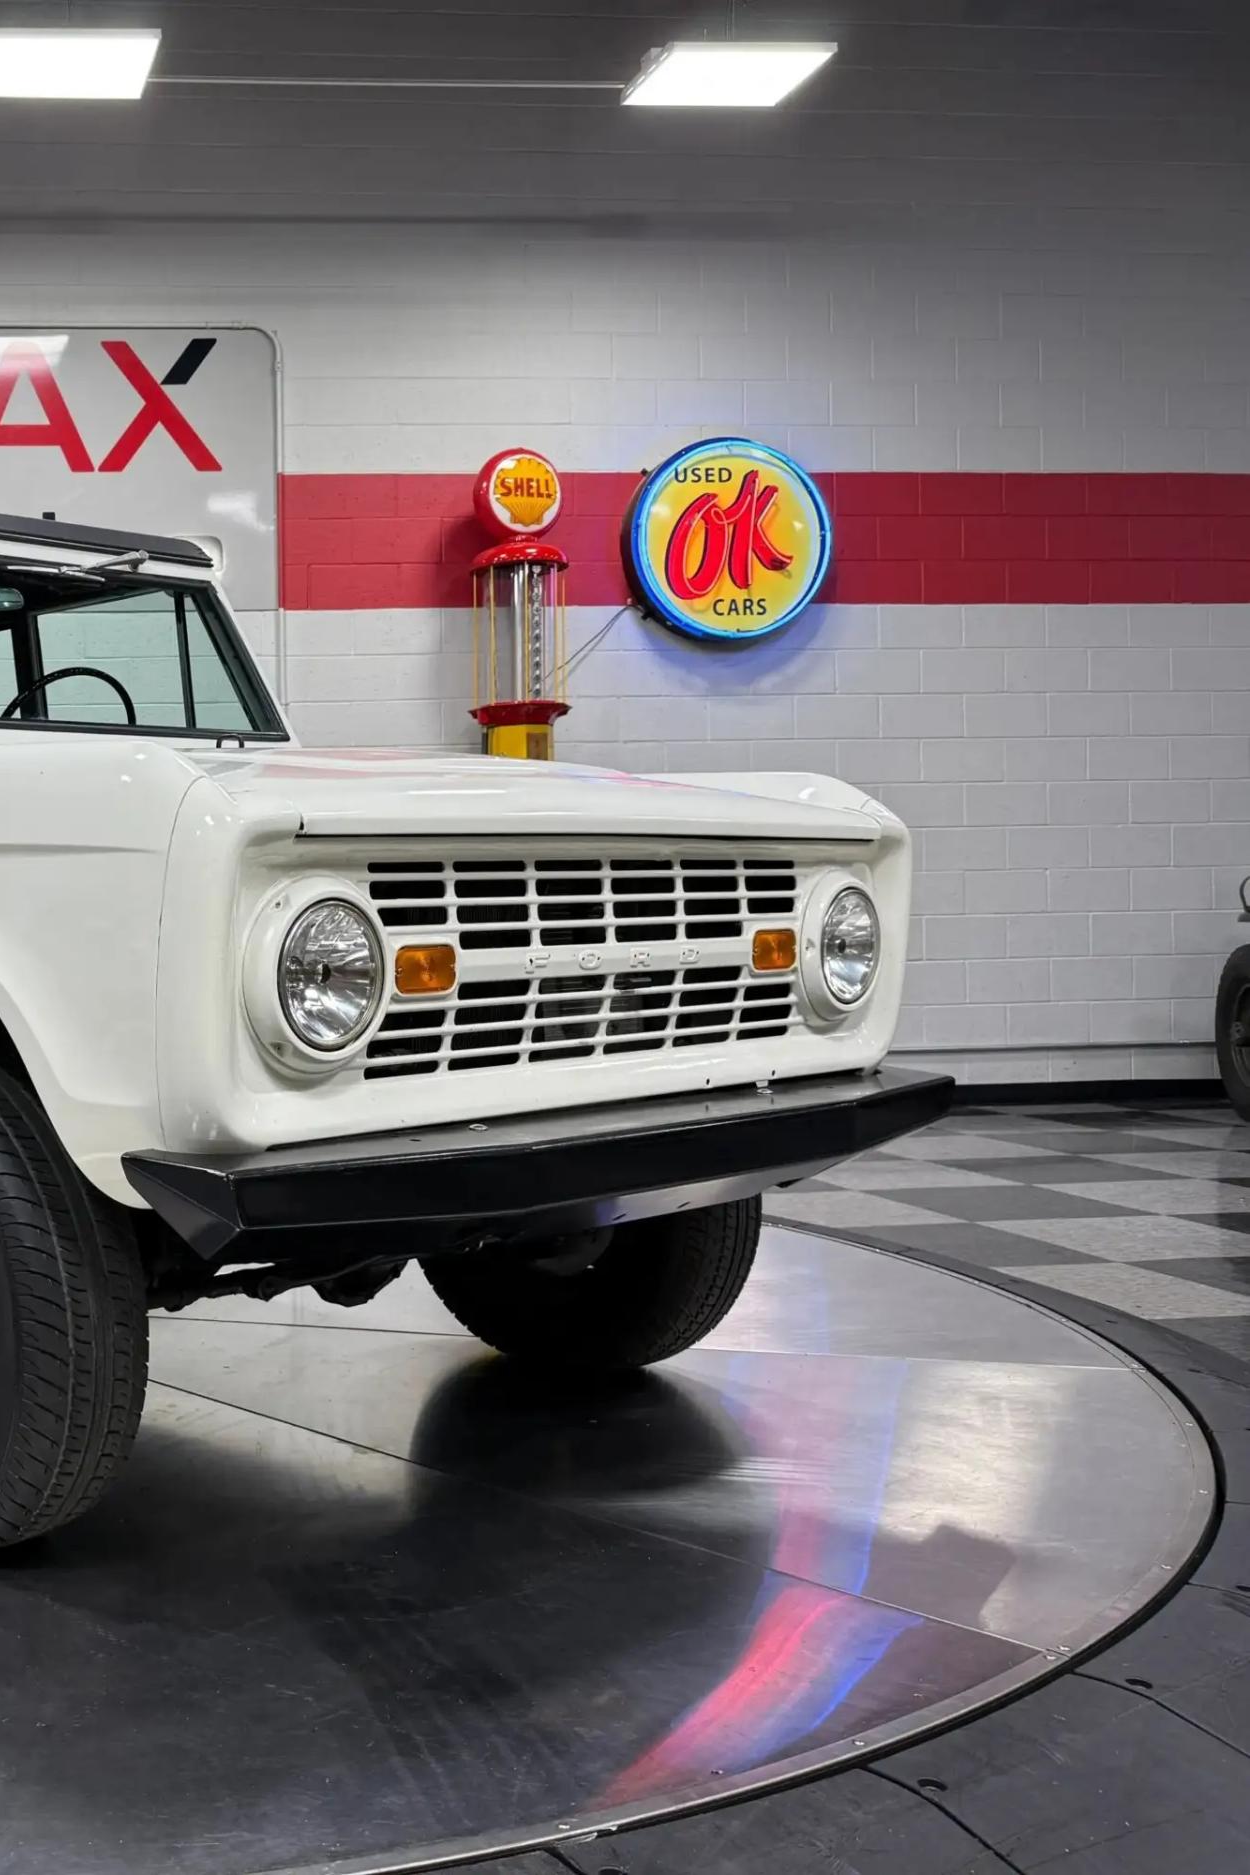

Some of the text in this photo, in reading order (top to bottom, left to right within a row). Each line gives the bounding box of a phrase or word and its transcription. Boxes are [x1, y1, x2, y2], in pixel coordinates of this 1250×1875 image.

[674, 467, 733, 483] USED
[499, 477, 553, 499] SHELL
[664, 469, 794, 601] OK
[712, 598, 768, 616] CARS
[524, 945, 700, 975] FORD
